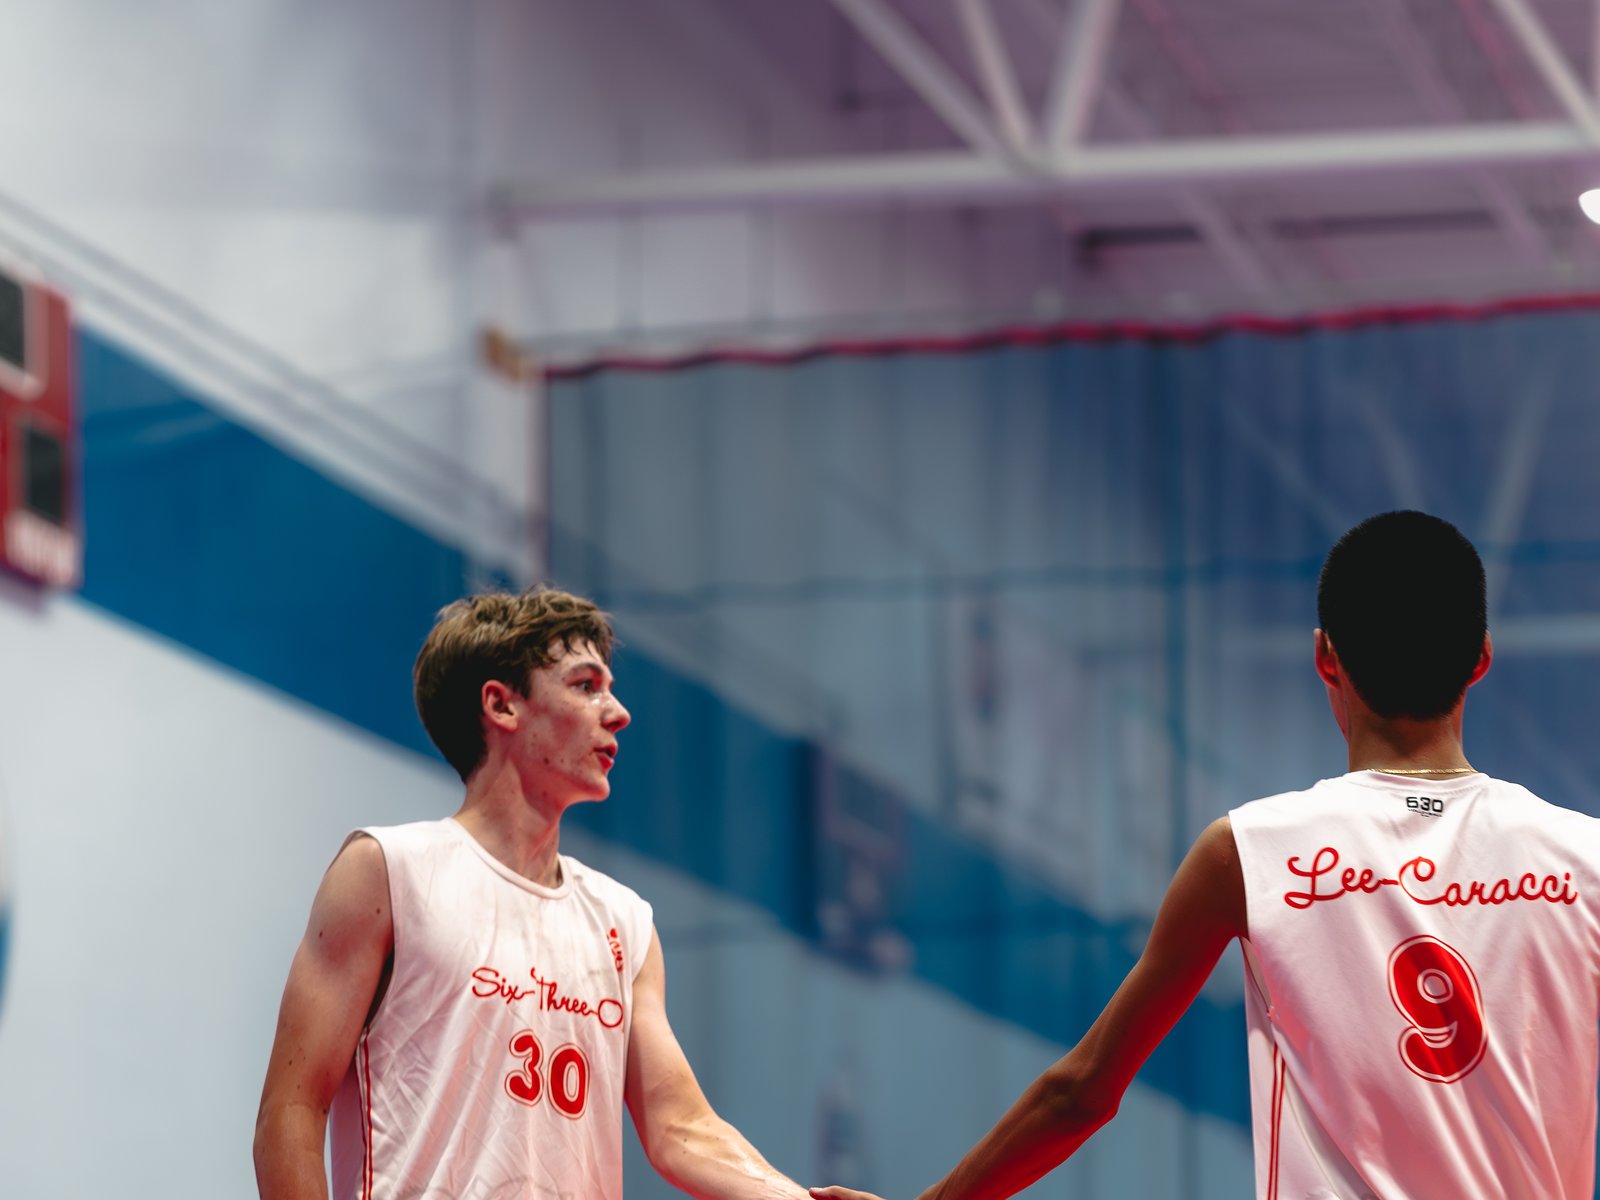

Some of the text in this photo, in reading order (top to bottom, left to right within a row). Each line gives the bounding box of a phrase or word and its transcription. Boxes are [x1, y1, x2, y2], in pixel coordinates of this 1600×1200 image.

[1406, 796, 1444, 813] 630
[1284, 847, 1578, 909] Lee-Caracci
[1388, 934, 1488, 1085] 9
[504, 1029, 590, 1120] 30
